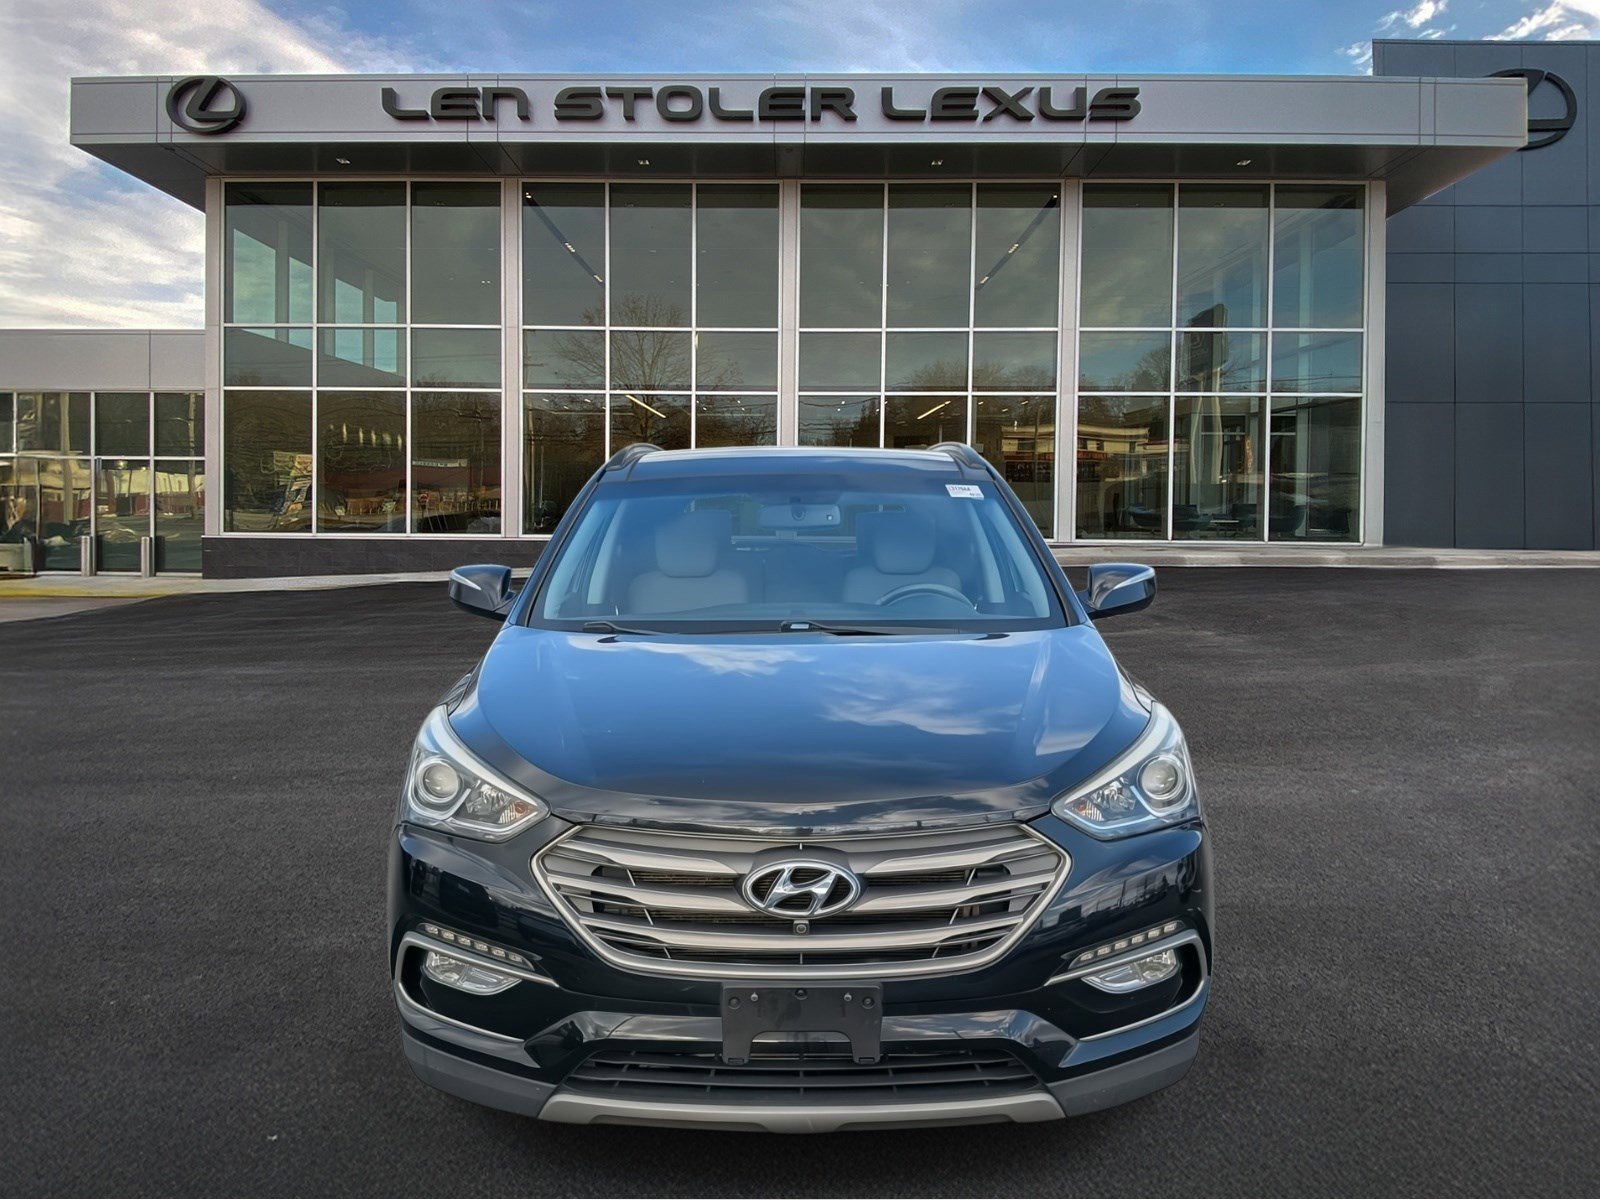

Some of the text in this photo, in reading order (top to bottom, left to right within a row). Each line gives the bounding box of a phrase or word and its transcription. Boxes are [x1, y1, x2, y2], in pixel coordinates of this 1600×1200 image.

[381, 84, 1142, 122] LEN STOLER LEXUS
